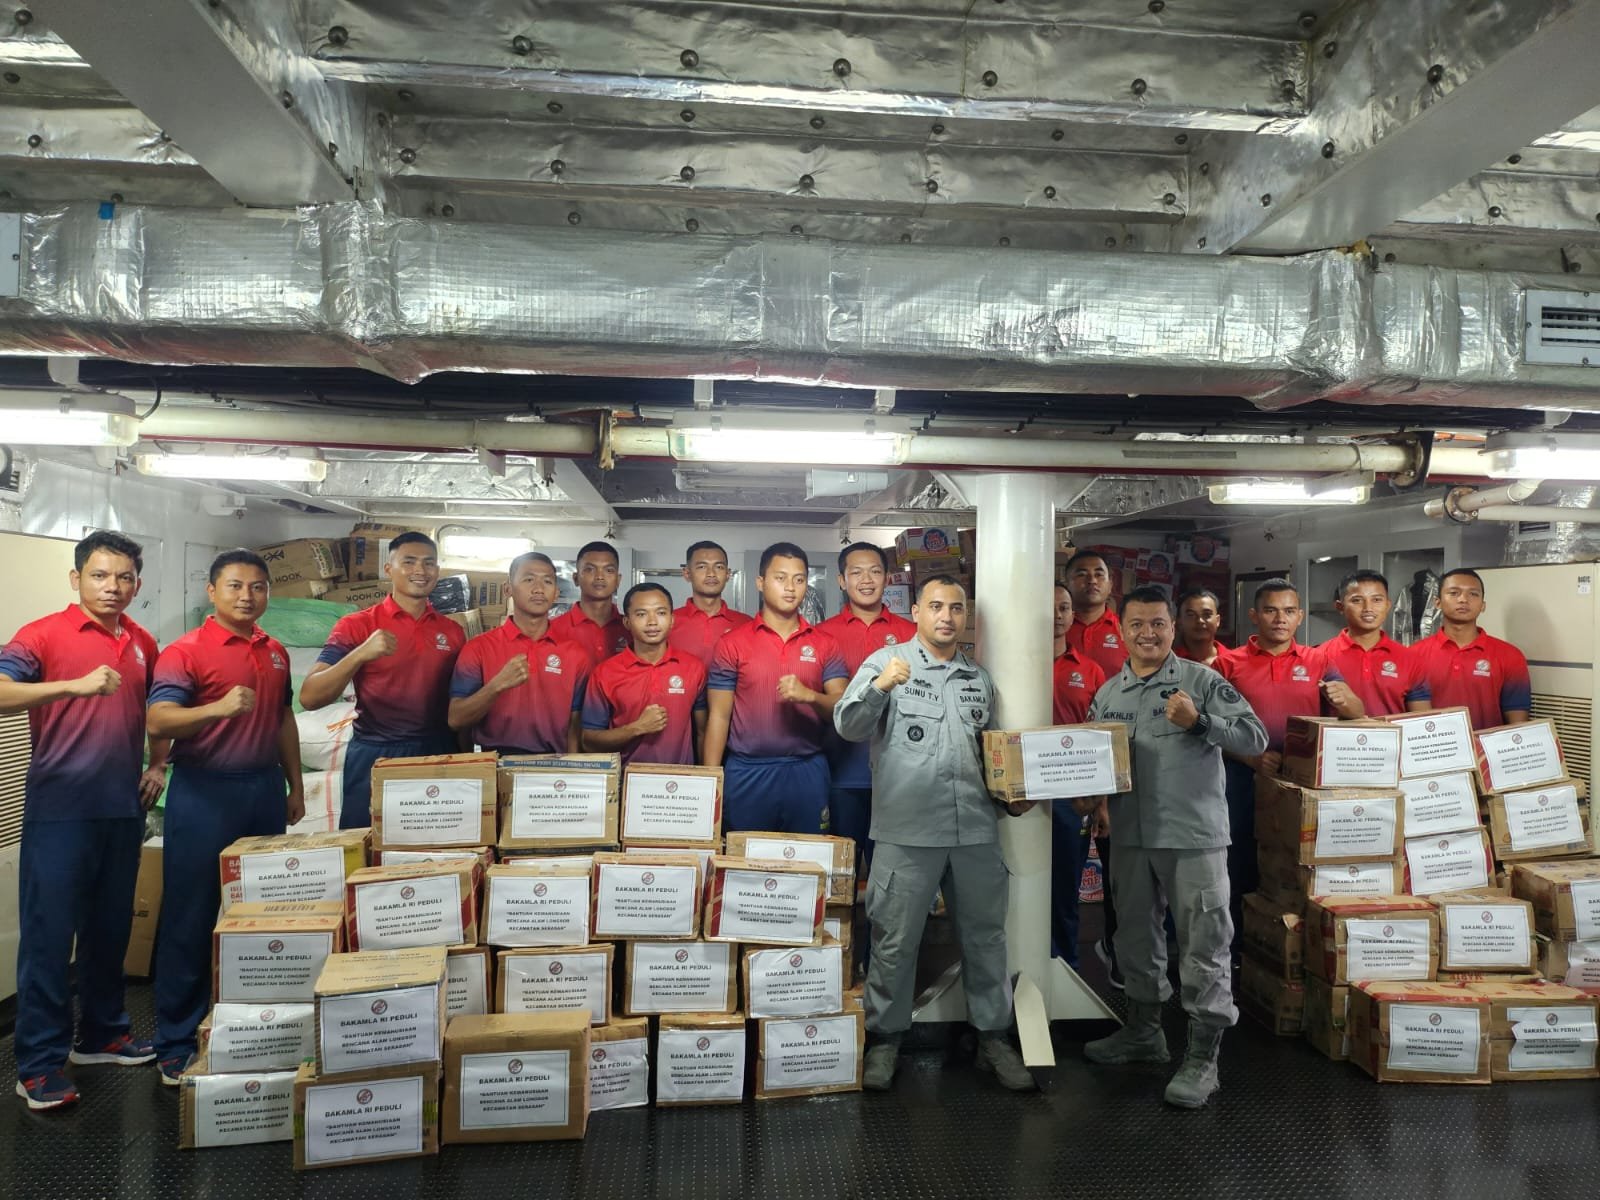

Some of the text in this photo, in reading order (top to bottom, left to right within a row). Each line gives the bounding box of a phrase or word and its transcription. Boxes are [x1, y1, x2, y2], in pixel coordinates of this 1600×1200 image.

[274, 572, 302, 583] HOOK
[346, 592, 372, 602] HOOK
[904, 686, 926, 698] SUNU
